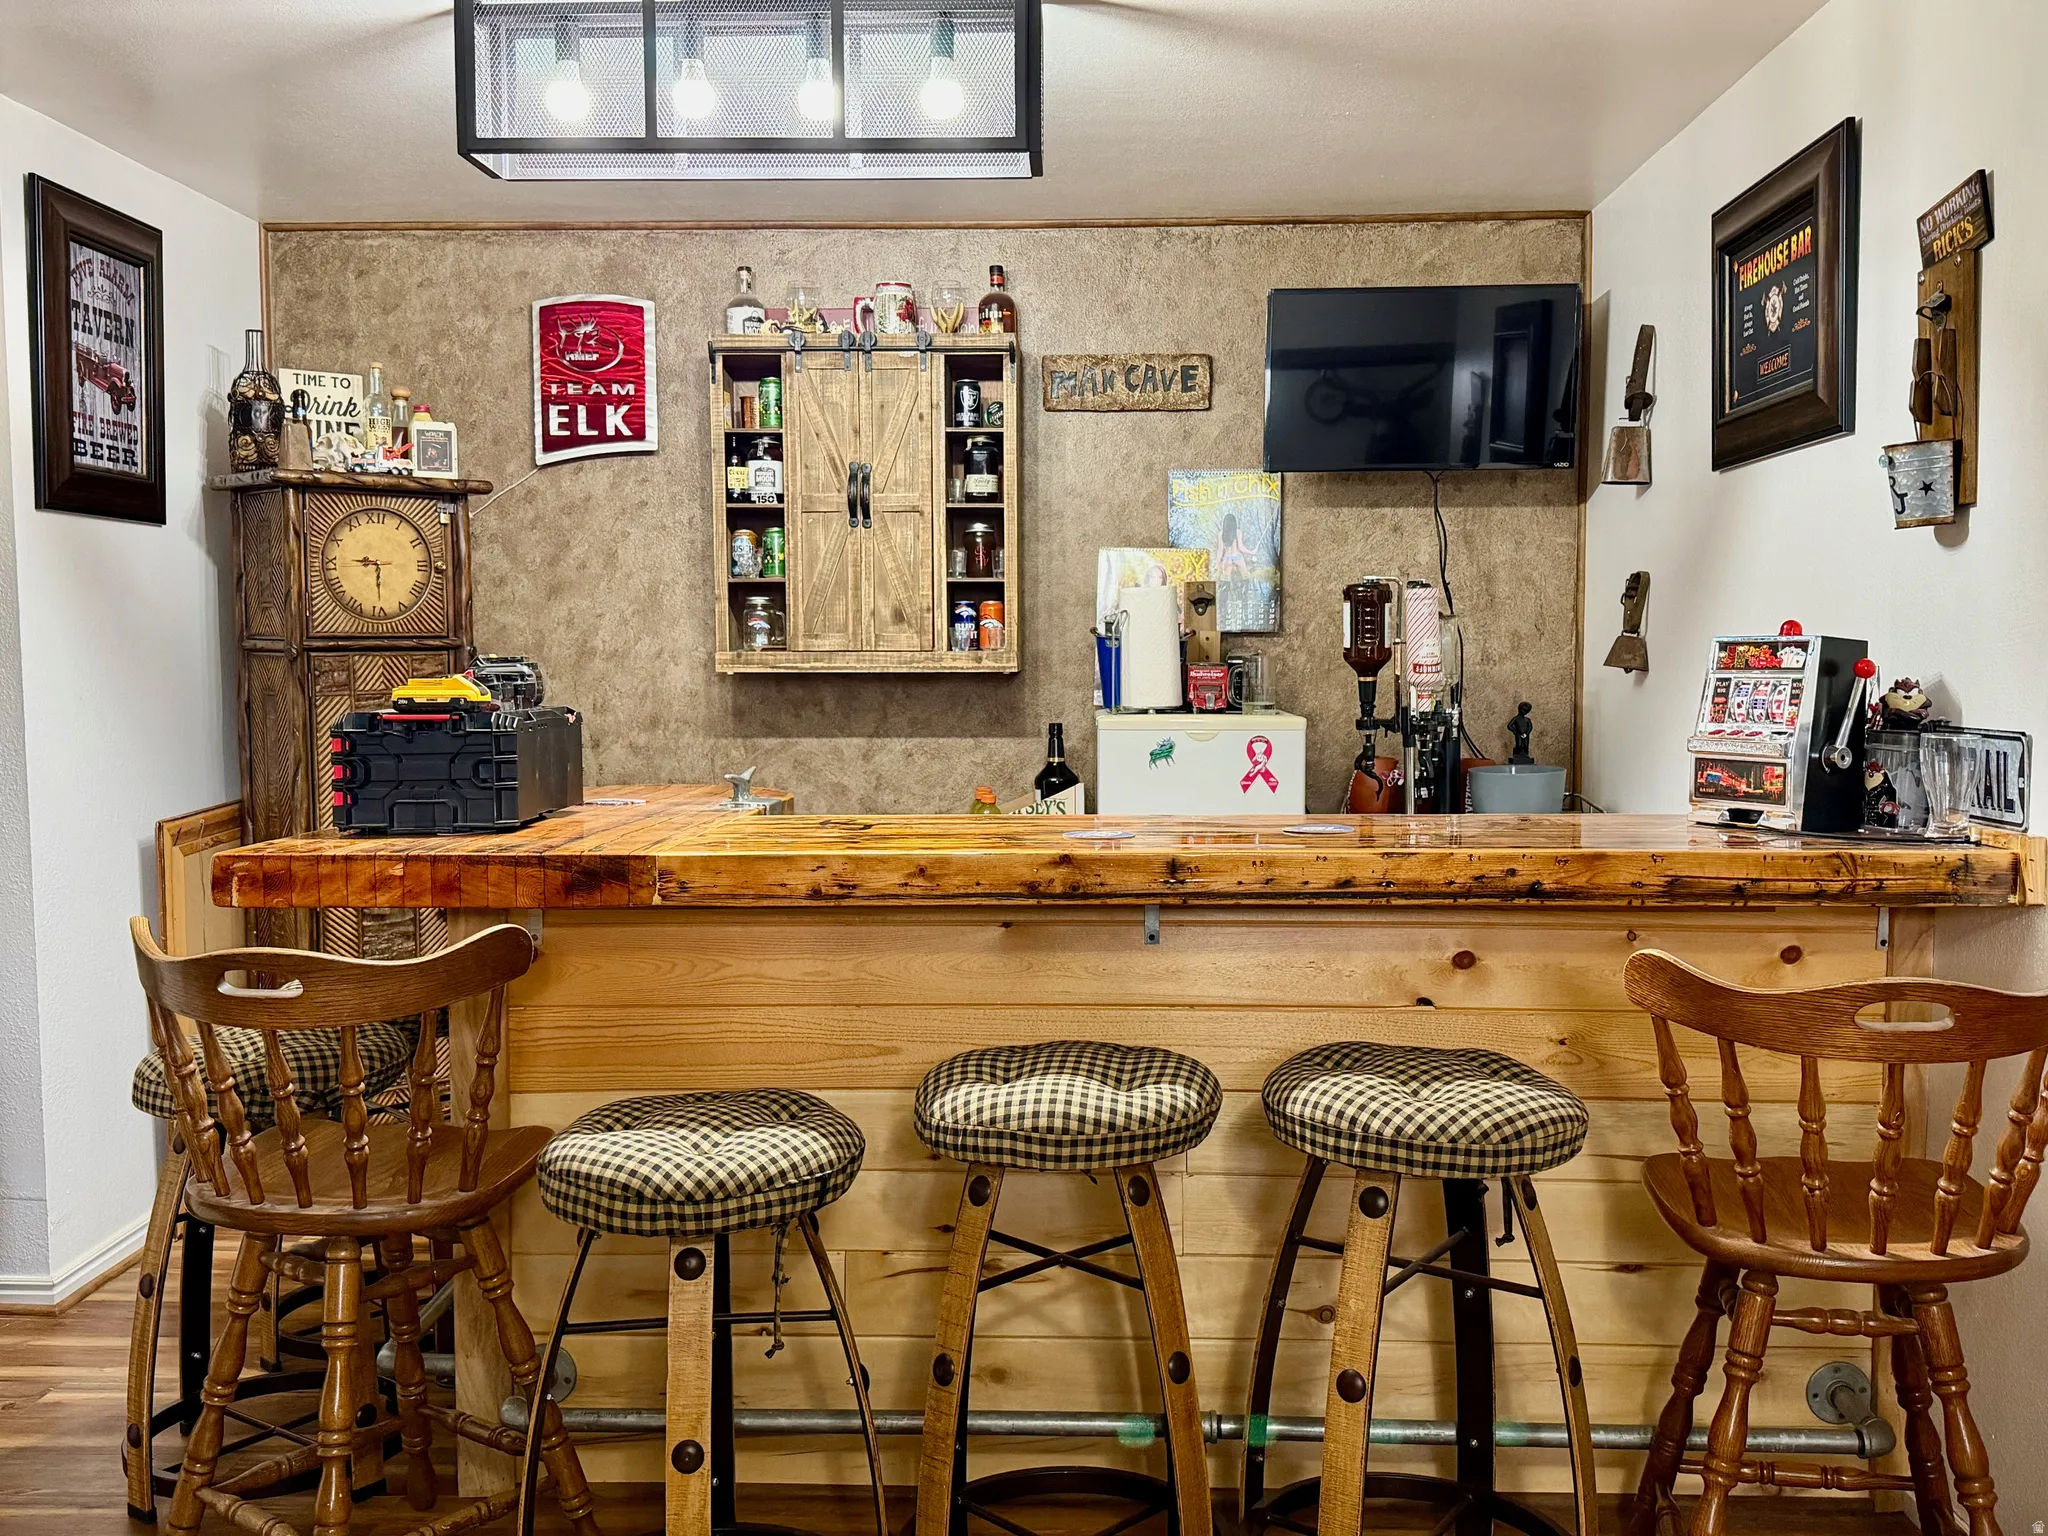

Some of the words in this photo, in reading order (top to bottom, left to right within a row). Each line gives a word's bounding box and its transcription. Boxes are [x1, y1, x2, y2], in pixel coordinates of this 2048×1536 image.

[1919, 215, 1933, 237] NO
[1934, 180, 1980, 225] WORKING
[1932, 216, 1974, 262] RICK'S
[1739, 238, 1789, 292] FIREHOUSE
[1790, 225, 1812, 260] BAR
[70, 258, 94, 288] FIVE
[99, 259, 135, 306] ALARM
[71, 298, 135, 349] TAVERN
[1759, 352, 1789, 377] WELCOME
[292, 372, 326, 387] TIME
[330, 376, 352, 390] TO
[547, 381, 635, 396] TEAM
[1050, 363, 1099, 399] MAN
[1124, 363, 1199, 394] CAVE
[72, 411, 94, 437] FIRE
[99, 417, 138, 446] BREWED
[549, 402, 634, 436] ELK
[73, 438, 139, 467] BEER
[756, 495, 775, 504] 150
[1171, 479, 1212, 501] Fish
[345, 515, 362, 532] XI
[364, 512, 387, 525] XII
[331, 532, 343, 548] X
[409, 537, 422, 550] II
[325, 555, 338, 572] IX
[416, 559, 429, 573] III
[327, 576, 346, 597] VIII
[408, 579, 426, 599] IIII
[345, 596, 364, 616] VII
[371, 605, 388, 617] VI
